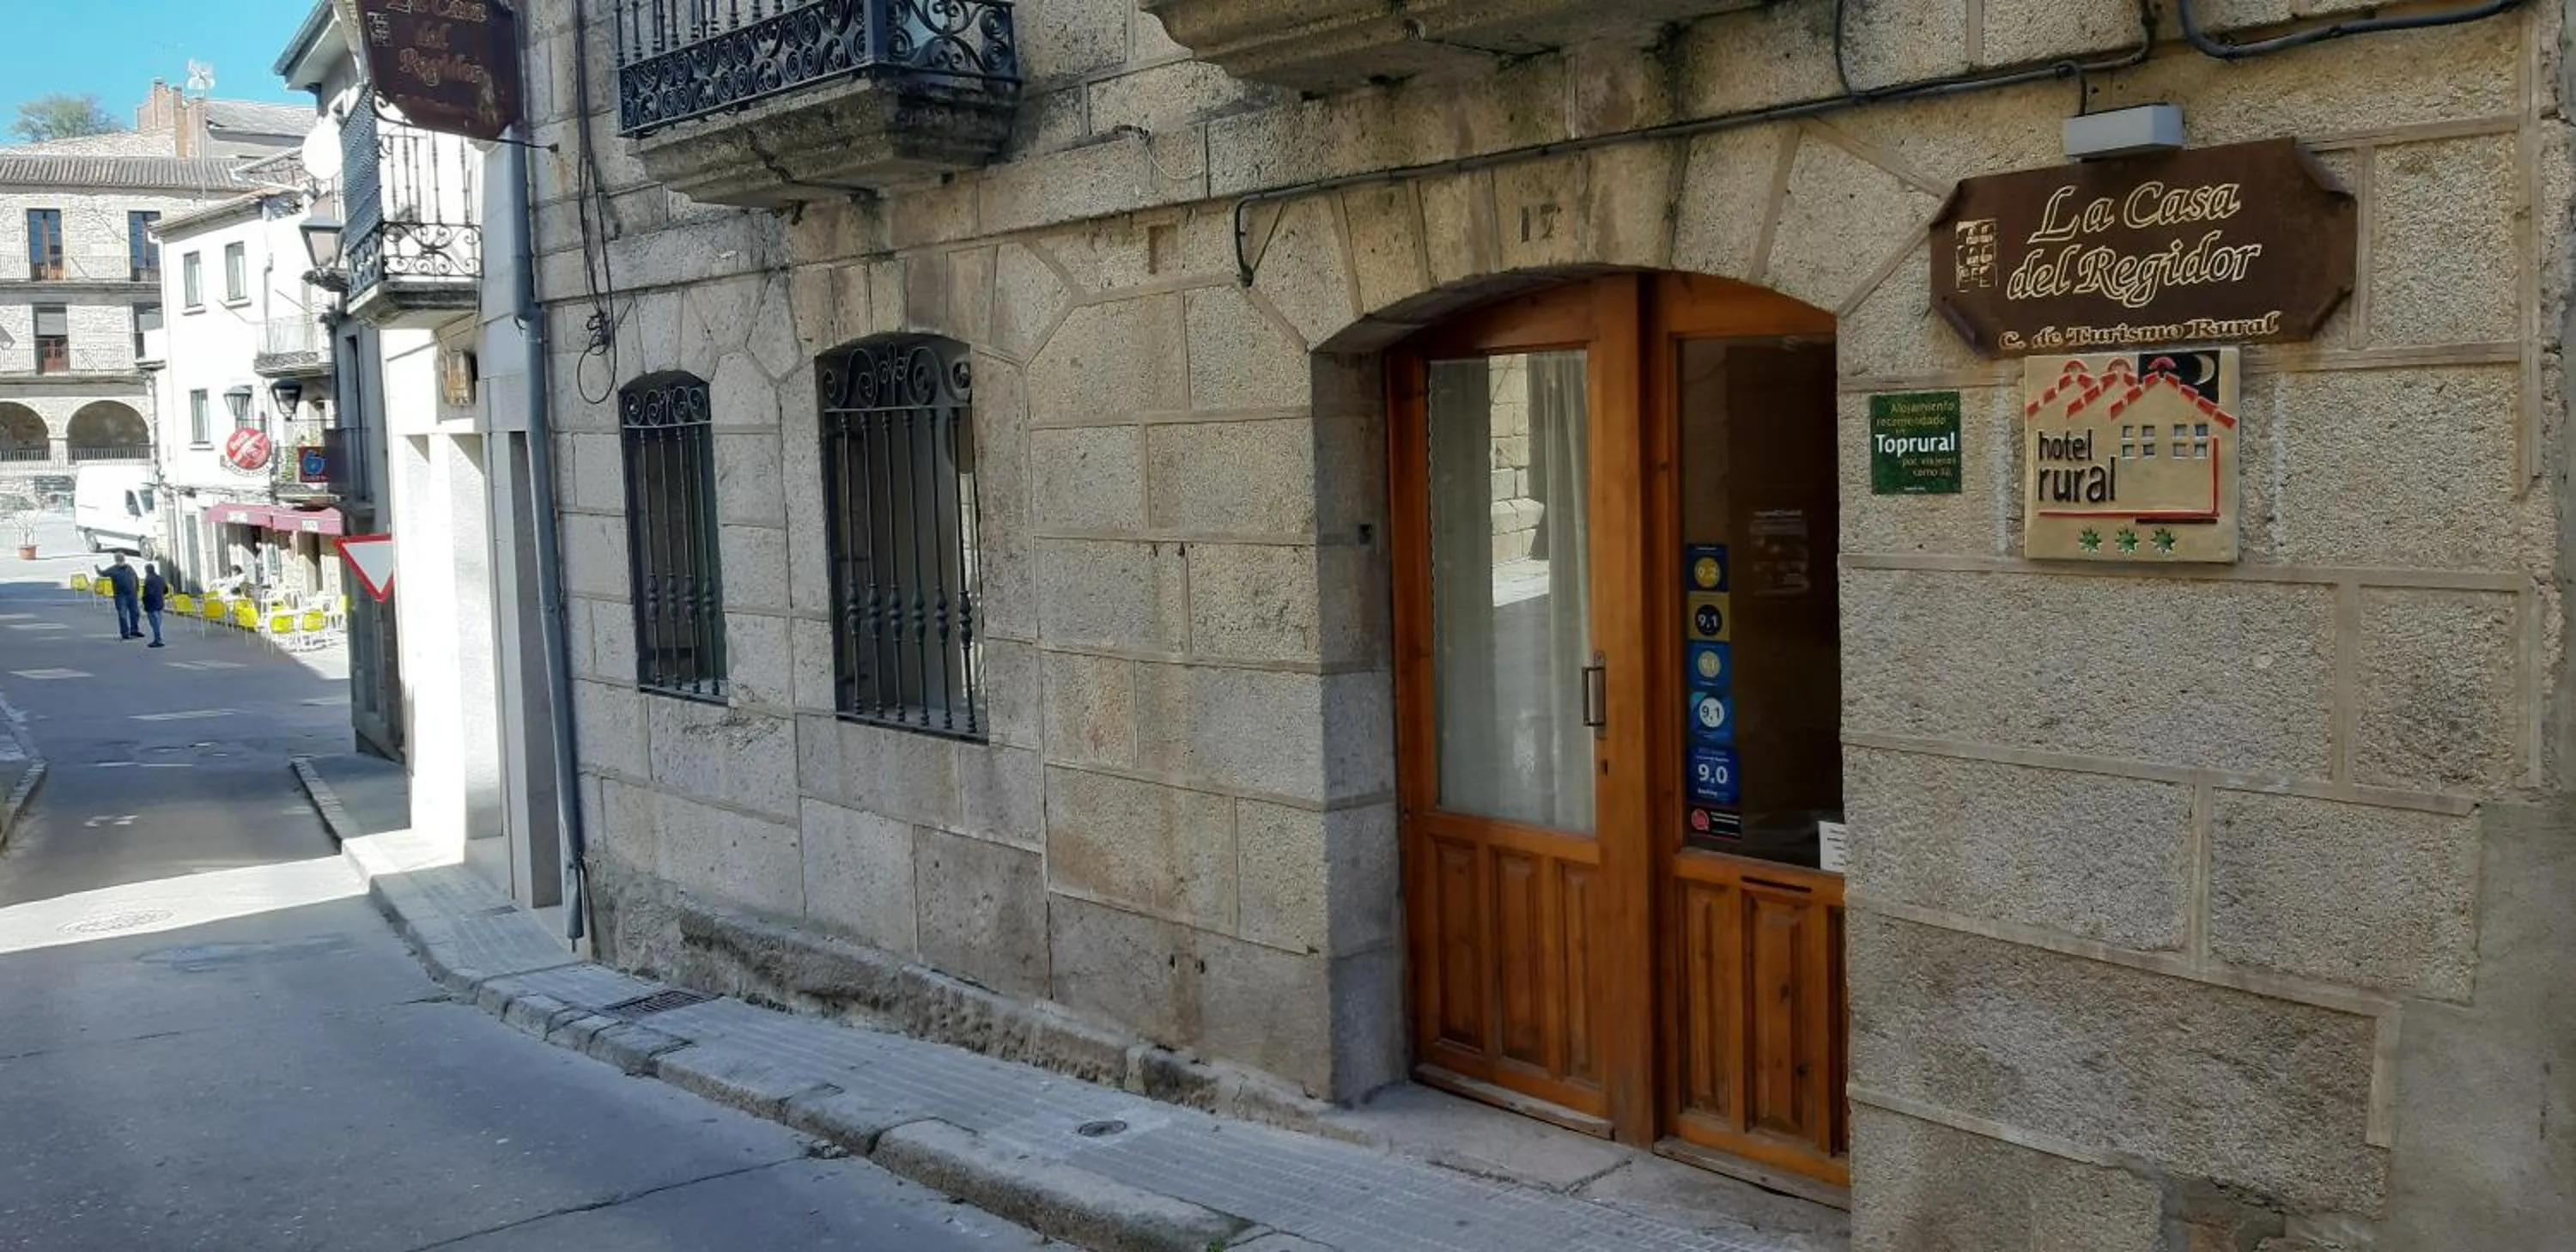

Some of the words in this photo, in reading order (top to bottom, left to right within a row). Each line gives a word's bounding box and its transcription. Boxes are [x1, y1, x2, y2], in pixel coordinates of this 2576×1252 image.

[2026, 185, 2115, 244] La
[2123, 180, 2241, 229] Casa
[2007, 244, 2081, 301] del
[2072, 229, 2263, 308] Regidor
[1997, 331, 2026, 350] C.
[2032, 325, 2064, 349] de
[2065, 322, 2184, 345] Turismo
[2184, 310, 2281, 340] Rural
[1874, 432, 1956, 458] Toprural
[2038, 428, 2093, 462] hotel
[2038, 456, 2117, 503] rural
[1697, 613, 1718, 629] 9,1
[1701, 705, 1722, 721] 9,1
[1698, 763, 1728, 785] 9.0
